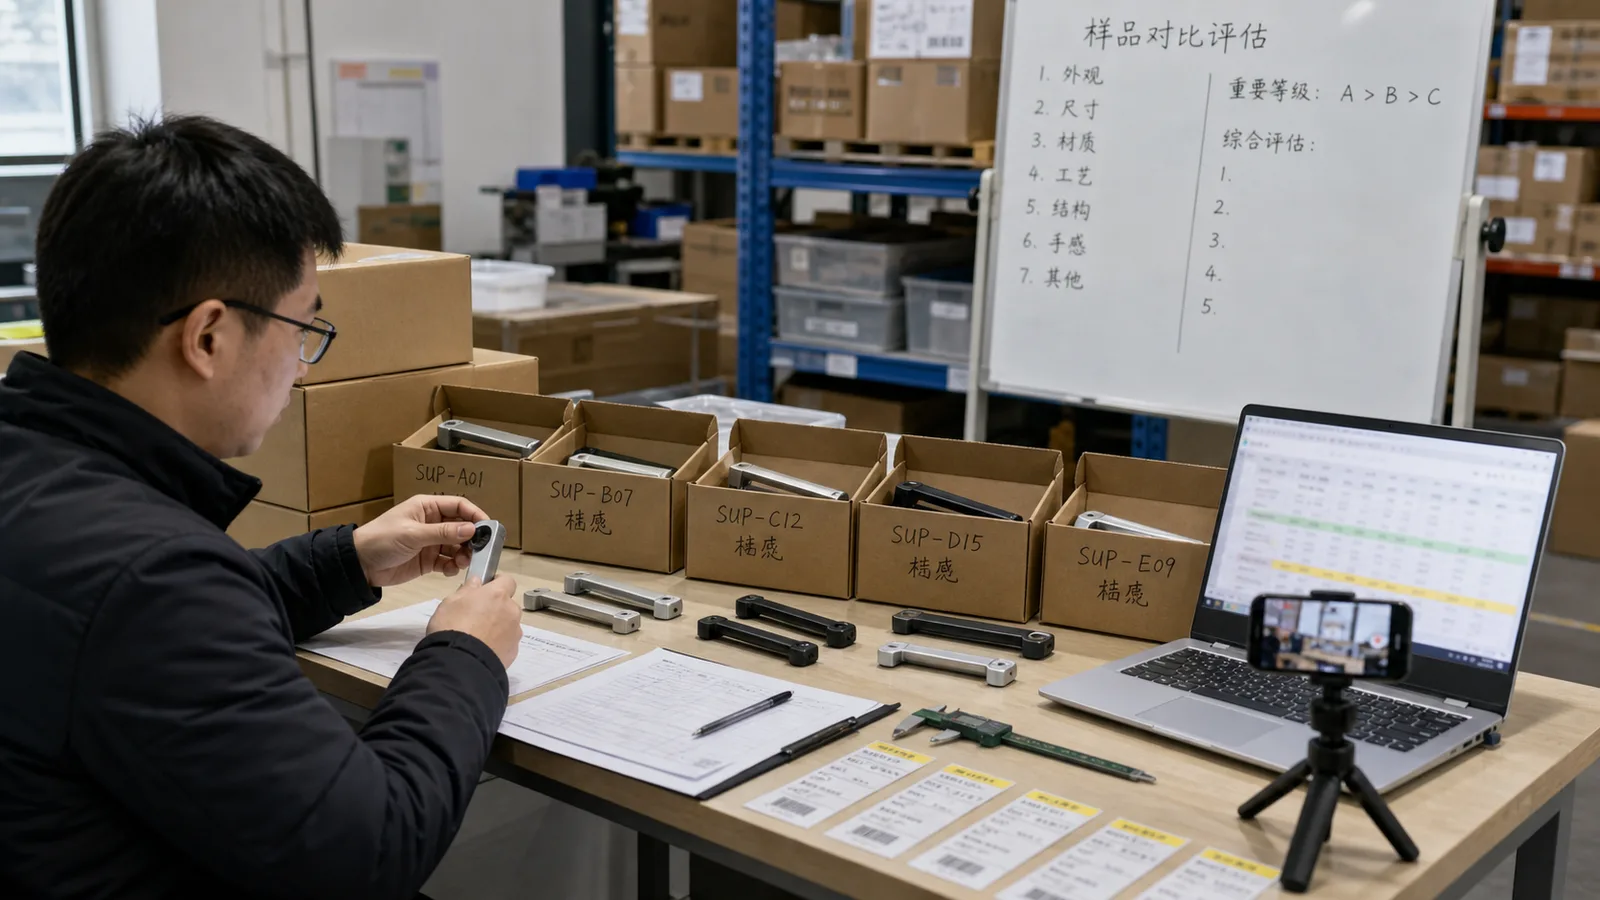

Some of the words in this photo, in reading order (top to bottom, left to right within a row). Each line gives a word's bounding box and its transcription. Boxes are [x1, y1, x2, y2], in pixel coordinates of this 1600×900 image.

[1084, 17, 1267, 54] 样品对比评估
[1040, 66, 1050, 80] 1.
[1064, 65, 1103, 85] 外观
[1341, 85, 1353, 102] A
[1386, 86, 1397, 104] B
[1428, 88, 1441, 105] C
[1034, 100, 1049, 114] 2.
[1062, 100, 1098, 120] 尺寸
[1032, 132, 1046, 148] 3.
[1058, 132, 1095, 153] 材质
[1029, 166, 1044, 181] 4.
[1056, 166, 1092, 186] 工艺
[1221, 166, 1231, 181] 1.
[1027, 199, 1040, 214] 5.
[1052, 199, 1090, 221] 结构
[1214, 200, 1229, 215] 2.
[1023, 232, 1037, 248] 6.
[1049, 233, 1085, 256] 手感
[1209, 233, 1224, 248] 3.
[1021, 268, 1033, 283] 7.
[1045, 268, 1083, 290] 其他
[1205, 265, 1221, 281] 4.
[1202, 298, 1215, 314] 5.
[416, 464, 482, 488] SUP-A01
[551, 481, 633, 507] SUP-B07
[716, 505, 803, 529] SUP-C12
[892, 525, 983, 551] SUP-D15
[1078, 547, 1175, 578] SUP-E09
